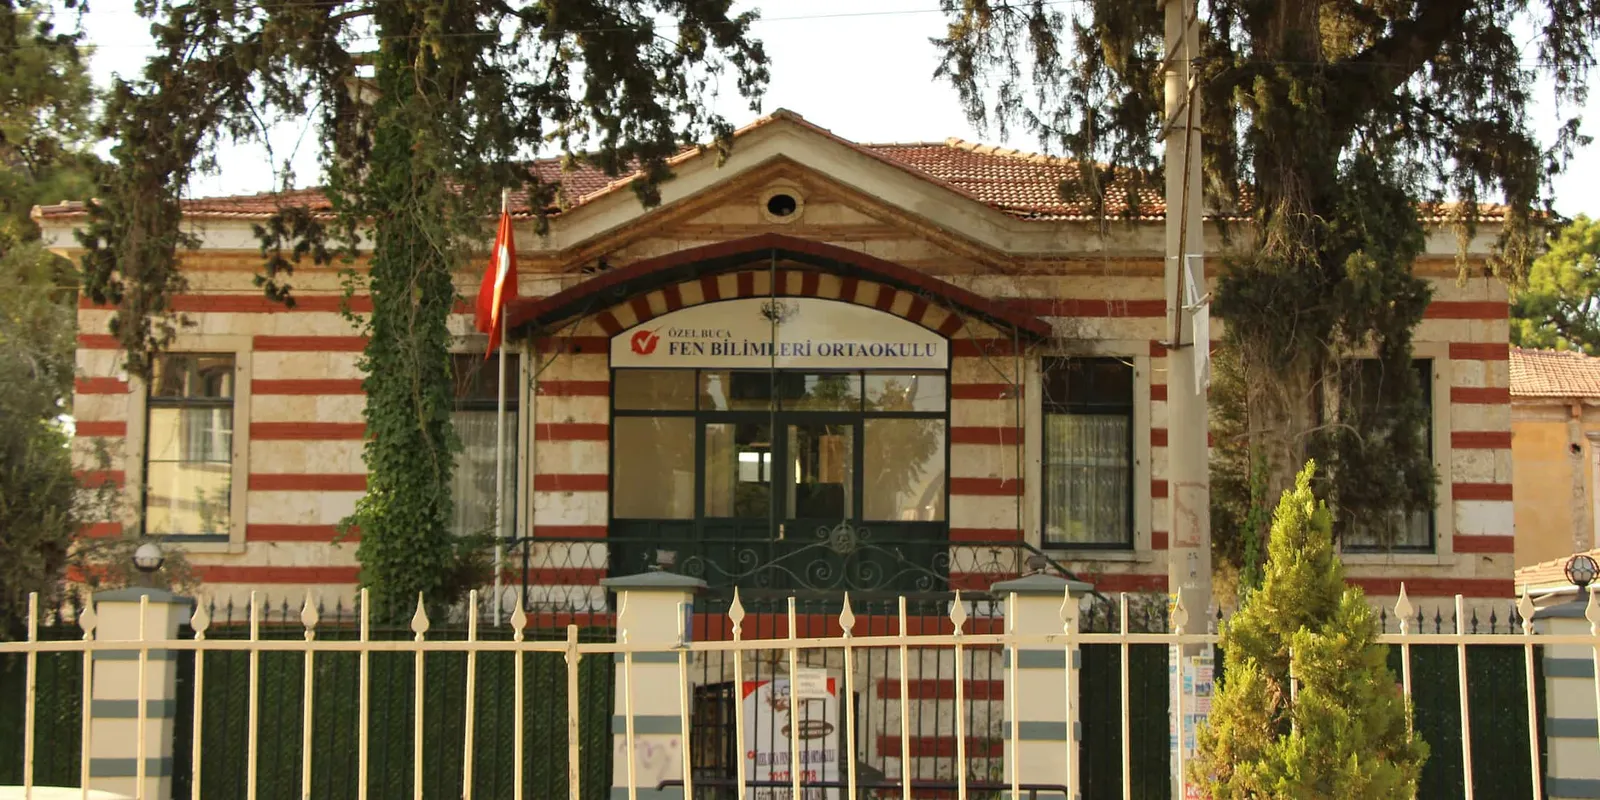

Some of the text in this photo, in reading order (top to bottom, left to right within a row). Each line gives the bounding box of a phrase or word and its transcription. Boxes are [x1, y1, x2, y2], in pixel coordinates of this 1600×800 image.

[668, 327, 732, 338] ÖZEL BUCA
[669, 339, 937, 357] FEN BİLİMLERİ ORTAOKULU
